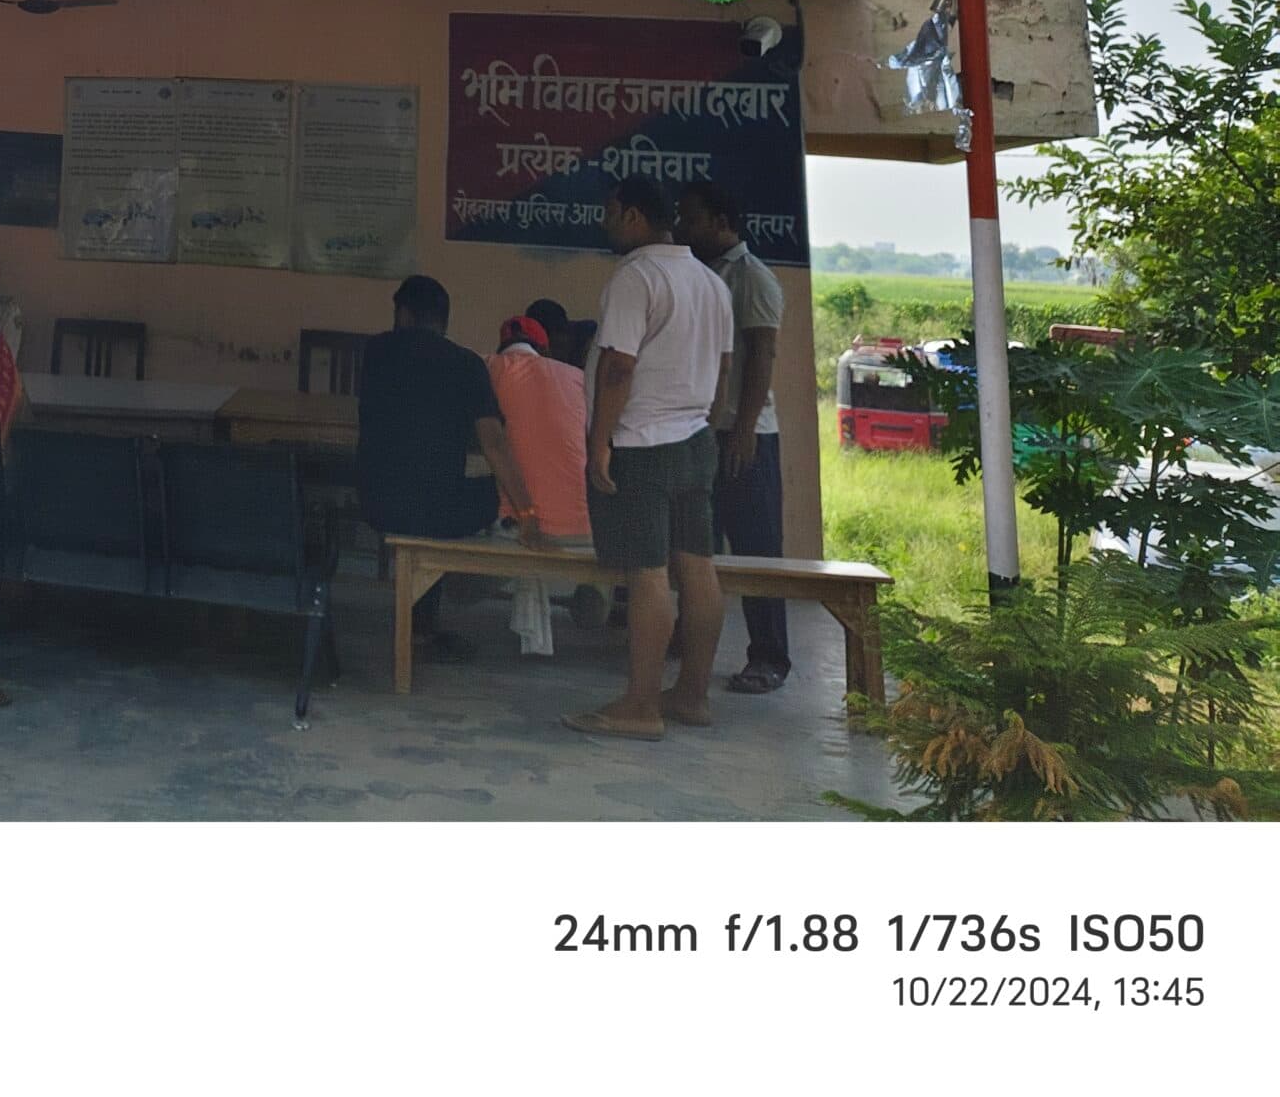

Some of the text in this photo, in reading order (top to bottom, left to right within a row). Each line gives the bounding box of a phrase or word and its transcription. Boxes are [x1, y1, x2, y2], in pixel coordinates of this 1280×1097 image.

[460, 53, 790, 128] भूमि विवाद जनता दरबार
[516, 193, 568, 229] पुलिस
